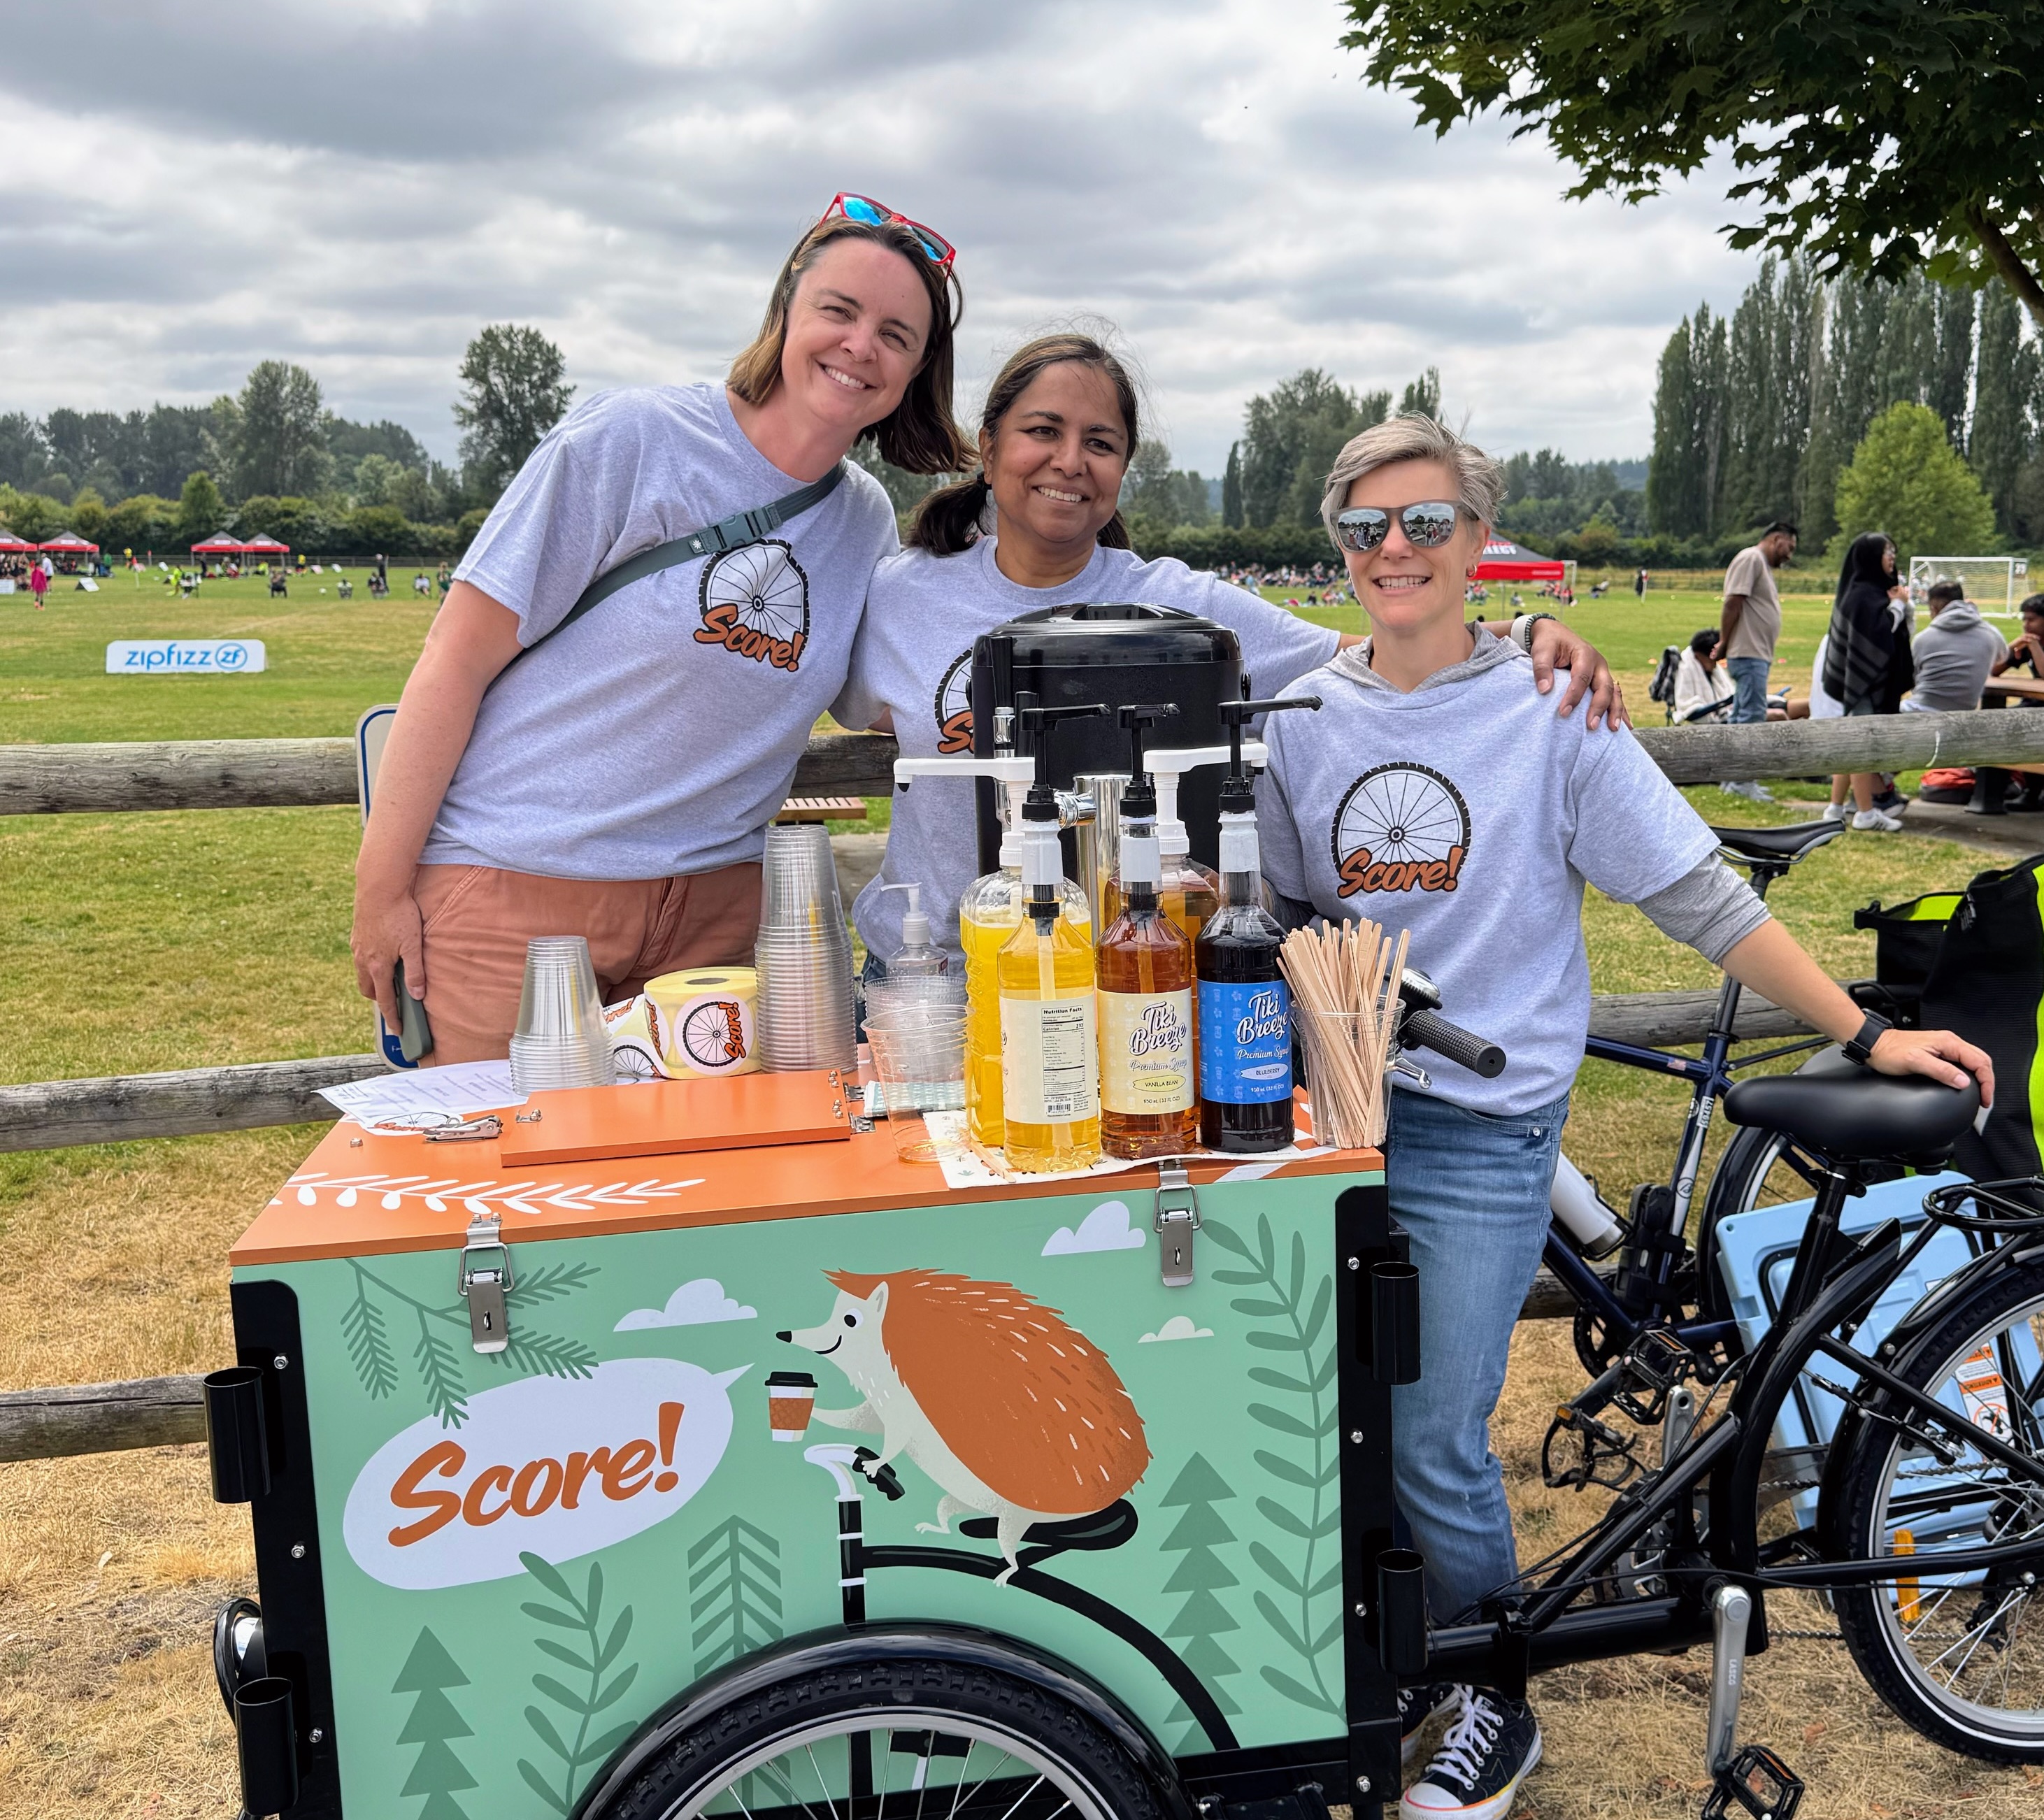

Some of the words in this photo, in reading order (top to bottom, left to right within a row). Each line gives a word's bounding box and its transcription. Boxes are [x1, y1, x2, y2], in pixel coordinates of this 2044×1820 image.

[693, 603, 805, 672] Score!
[124, 643, 213, 671] zipfizz
[1337, 845, 1464, 899] Score!
[1141, 1001, 1177, 1035] Tiki
[1248, 990, 1281, 1023] Tiki
[717, 1001, 747, 1059] Score!
[1129, 1023, 1187, 1056] Breeze
[1236, 1012, 1288, 1045] Breeze
[1129, 1059, 1169, 1072] Premium
[1237, 1049, 1273, 1060] Premium
[387, 1401, 685, 1547] Score!
